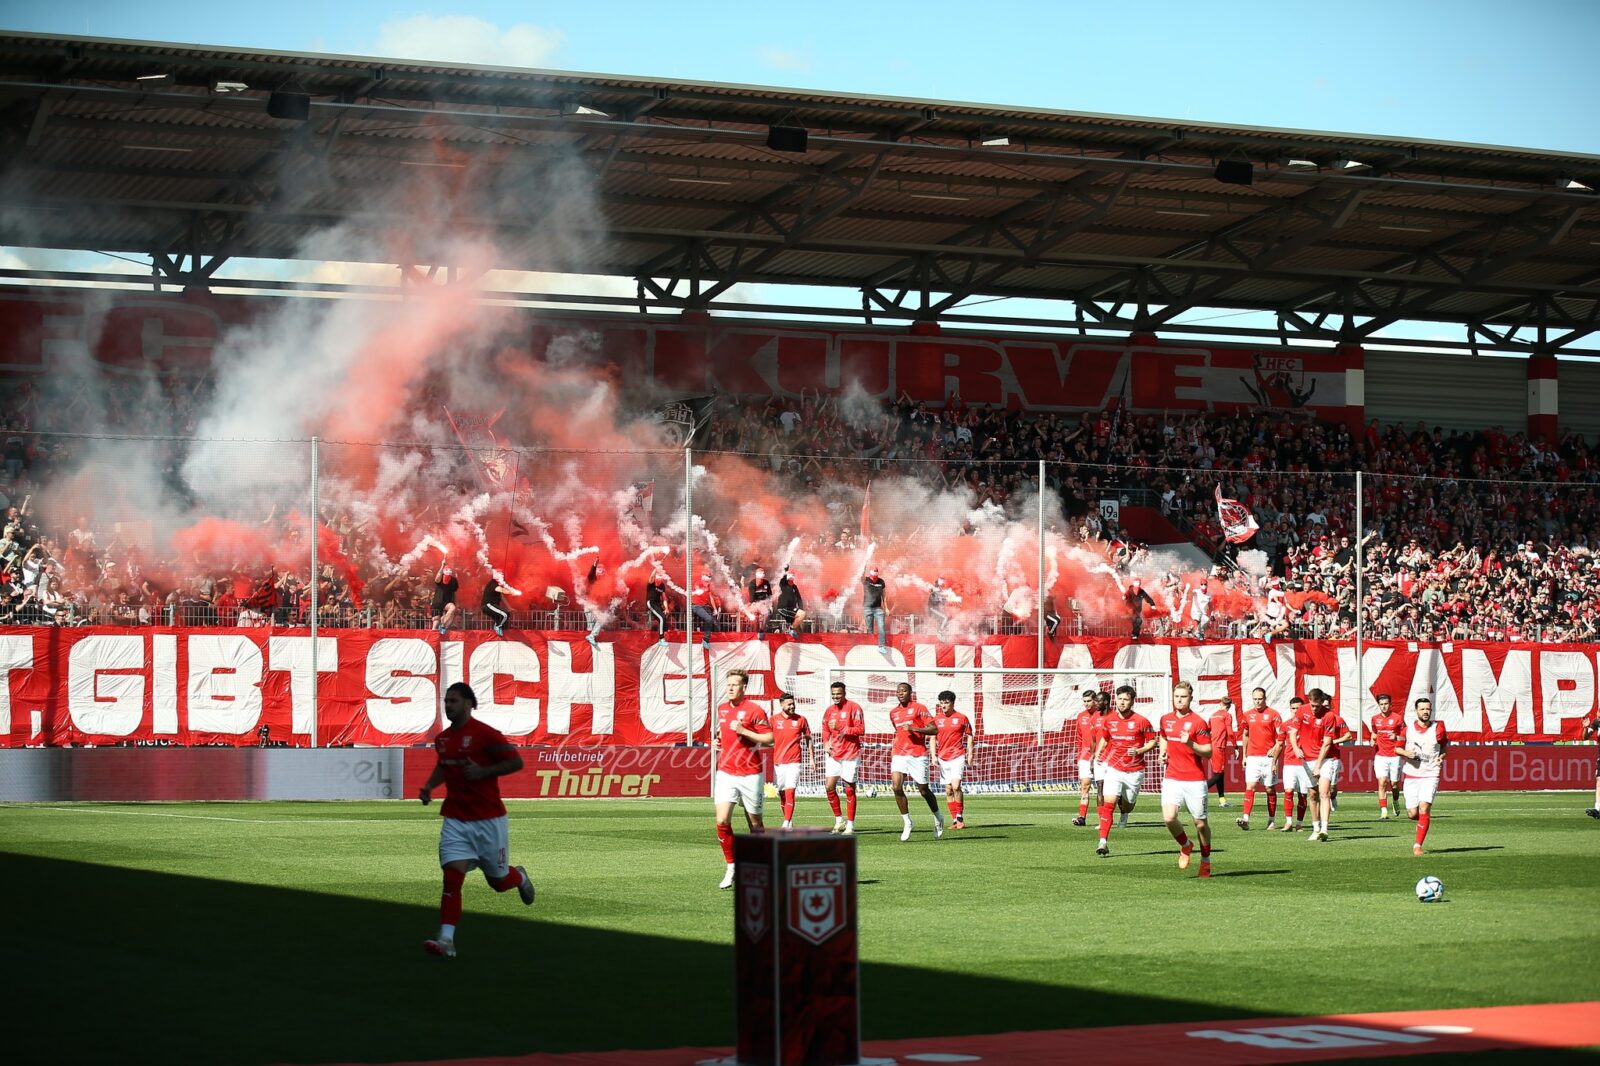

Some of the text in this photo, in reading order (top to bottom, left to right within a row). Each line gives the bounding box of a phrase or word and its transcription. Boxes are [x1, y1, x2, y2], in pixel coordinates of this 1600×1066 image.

[1266, 358, 1297, 370] HFC
[1101, 505, 1118, 518] 19a
[68, 634, 338, 736] GIBT
[365, 637, 615, 736] SICH
[537, 750, 604, 763] Fuhrbetrieb
[1441, 750, 1498, 782] und
[793, 869, 839, 885] HFC
